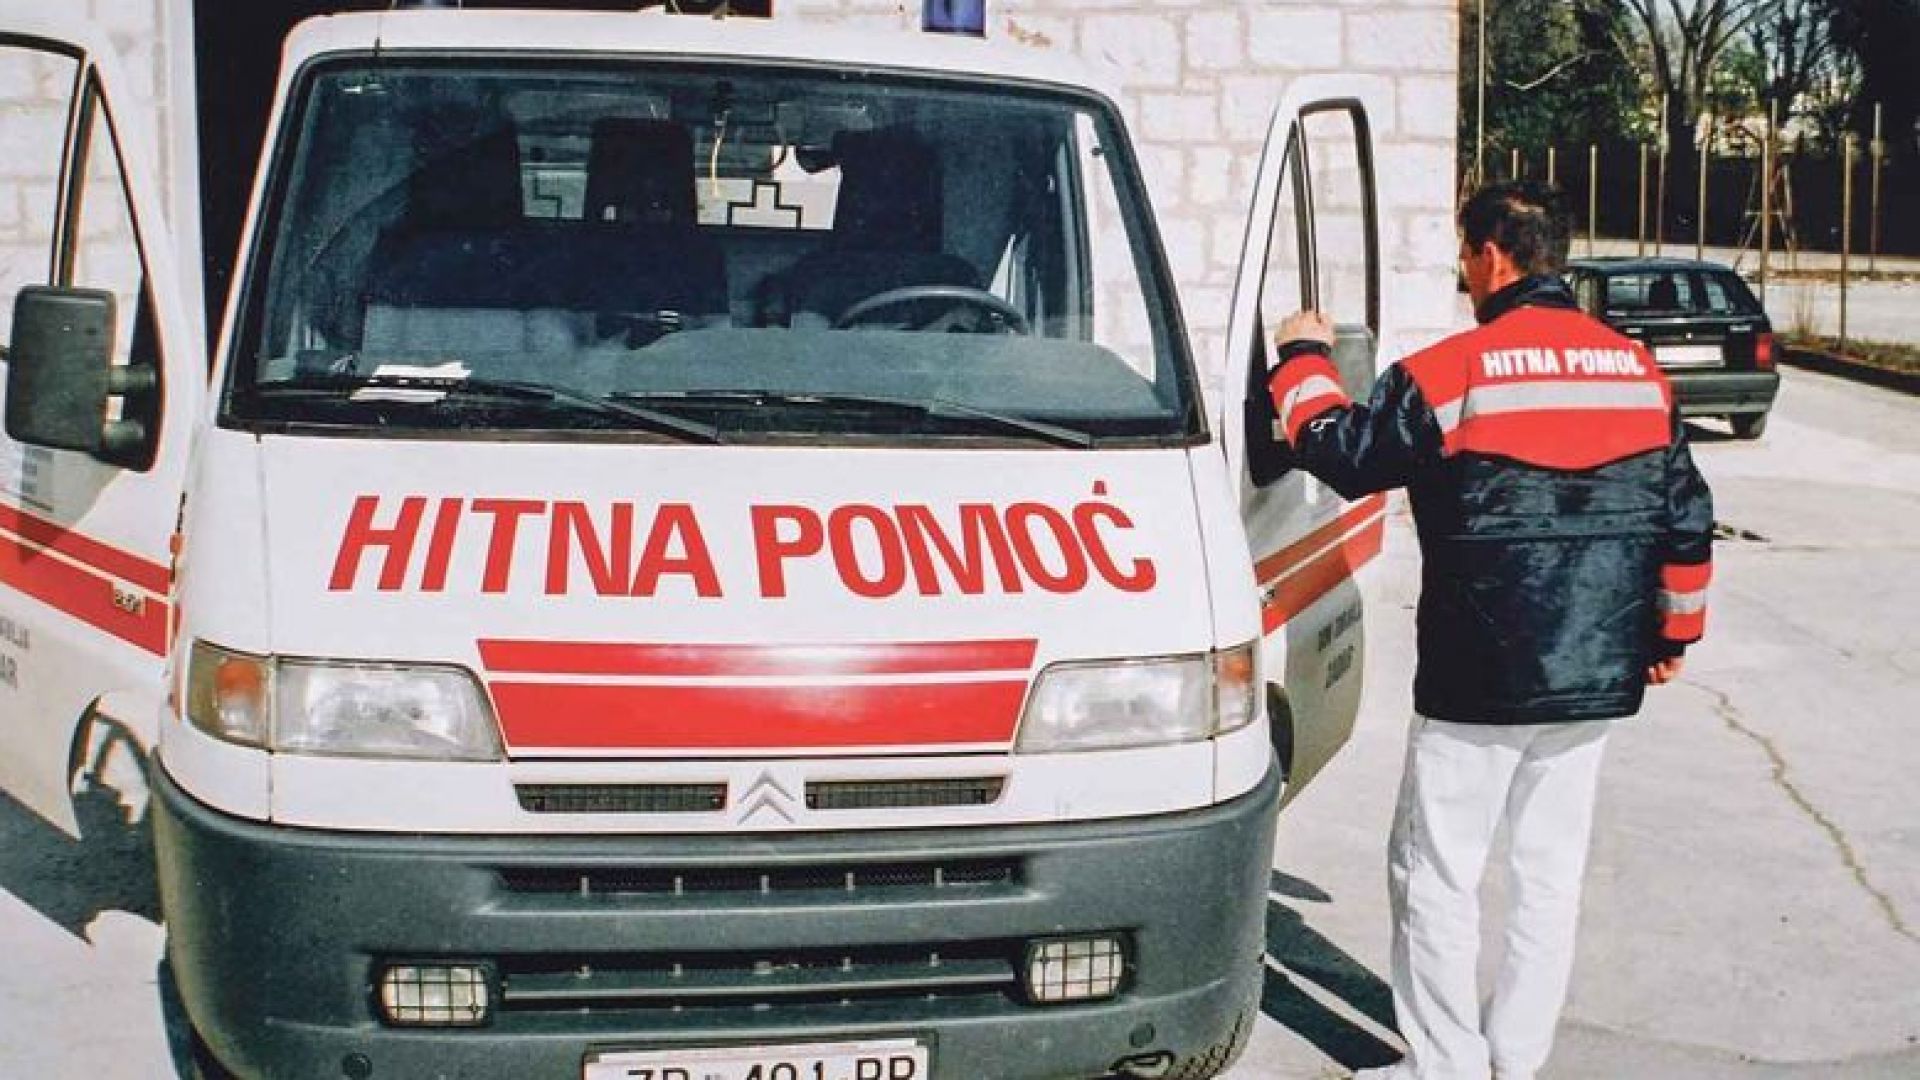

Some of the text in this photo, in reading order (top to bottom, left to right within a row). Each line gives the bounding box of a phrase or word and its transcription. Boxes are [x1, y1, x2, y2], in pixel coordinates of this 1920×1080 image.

[1481, 348, 1561, 378] HITNA
[328, 481, 1157, 599] HITNA POMOĆ
